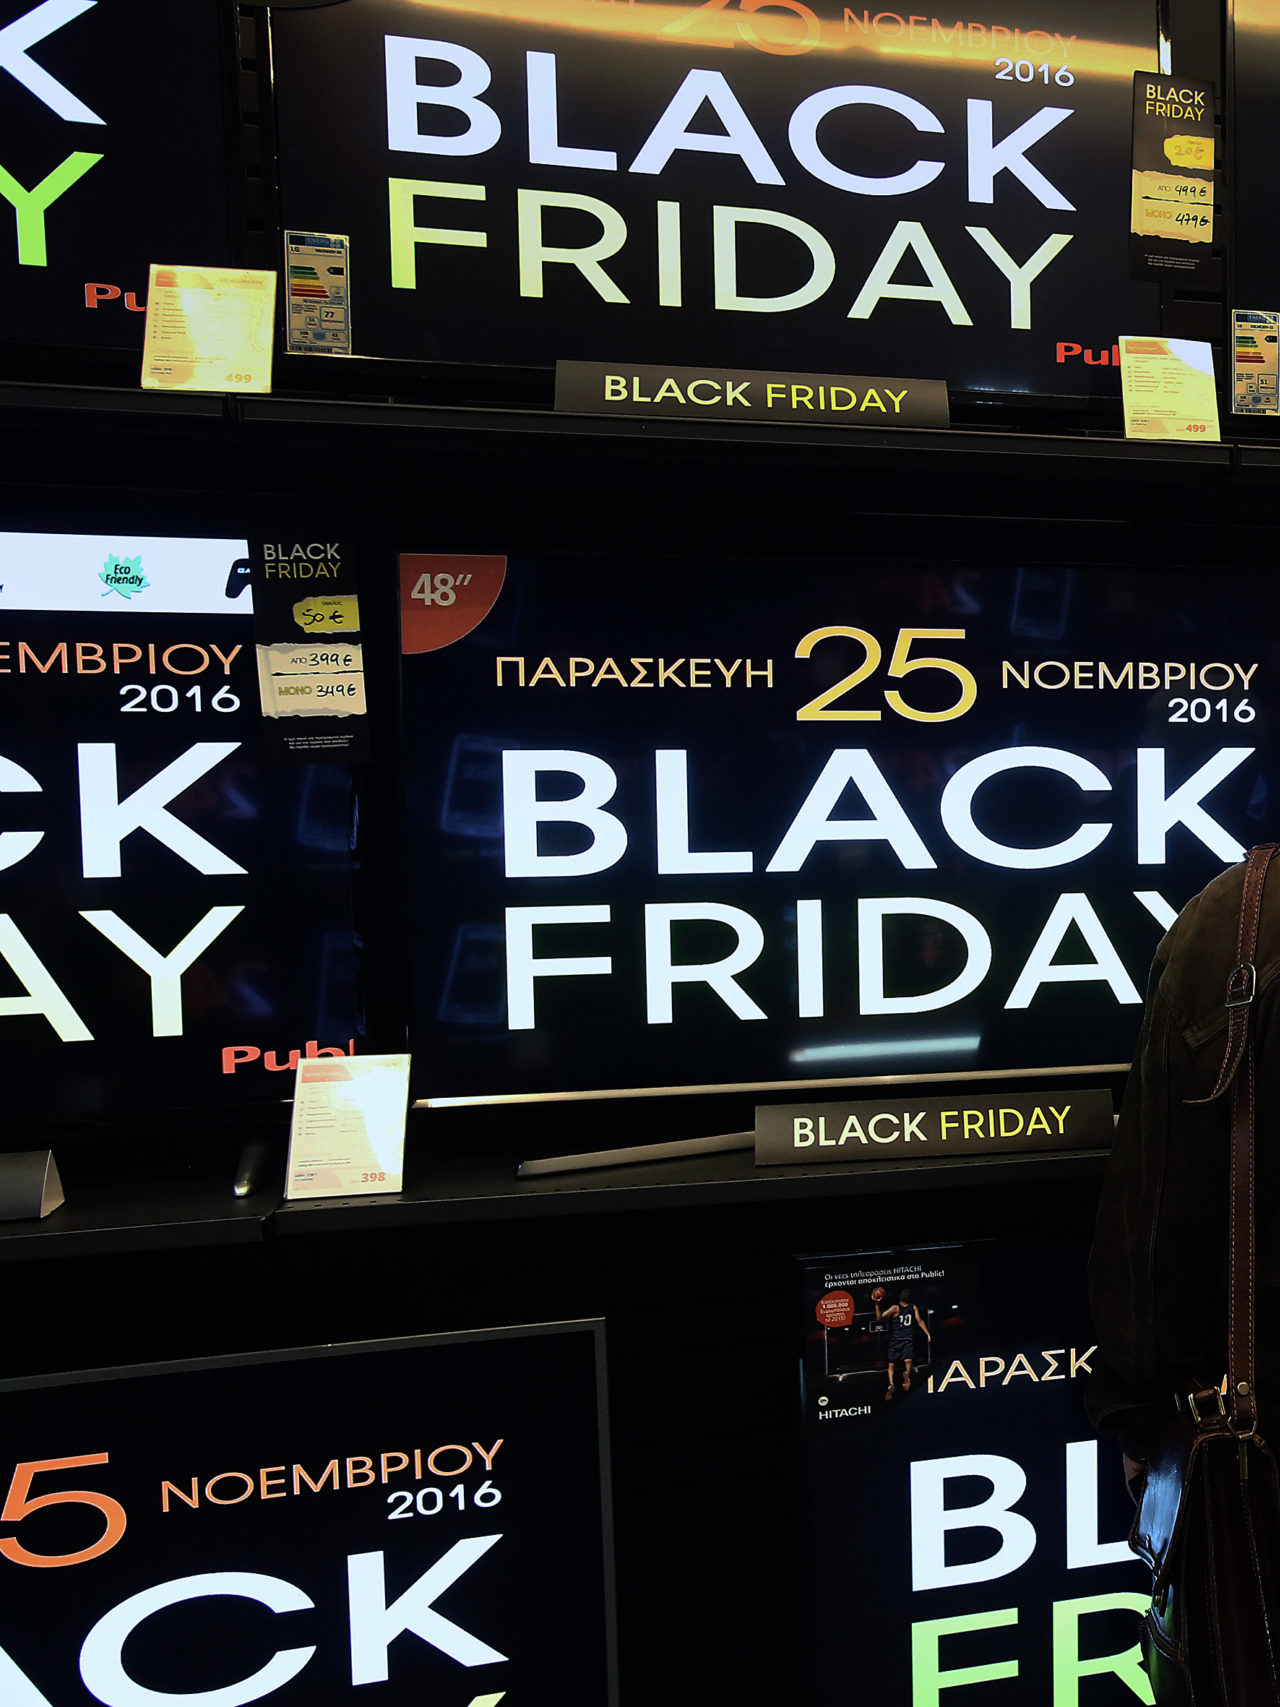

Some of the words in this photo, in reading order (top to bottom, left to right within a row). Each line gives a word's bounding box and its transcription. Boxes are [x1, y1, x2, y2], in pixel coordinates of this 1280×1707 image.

[994, 57, 1075, 87] 2016
[1146, 84, 1205, 106] BLACK
[384, 35, 1077, 212] BLACK
[1145, 101, 1204, 121] FRIDAY
[388, 177, 1075, 330] FRIDAY
[225, 373, 252, 383] 499
[604, 375, 752, 407] BLACK
[766, 382, 908, 414] FRIDAY
[1186, 424, 1206, 432] 499
[263, 543, 341, 561] BLACK
[105, 574, 144, 587] Friendly
[114, 564, 131, 575] Eco
[264, 562, 341, 579] FRIDAY
[496, 656, 773, 688] ΠΑΡΑΣΚΕΥΗ
[794, 625, 978, 722] 25
[1001, 660, 1259, 690] ΝΟΕΜΒΡΙΟΥ
[119, 684, 241, 713] 2016
[1167, 697, 1256, 722] 2016
[501, 745, 1256, 878] BLACK
[792, 1112, 928, 1148] BLACK
[940, 1105, 1072, 1142] FRIDAY
[360, 1172, 386, 1183] 398
[893, 1265, 922, 1274] HITACHI
[818, 1405, 872, 1420] HITACHI
[161, 1439, 504, 1513] ΝΟΕΜΒΡΙΟΥ
[387, 1480, 502, 1520] 2016
